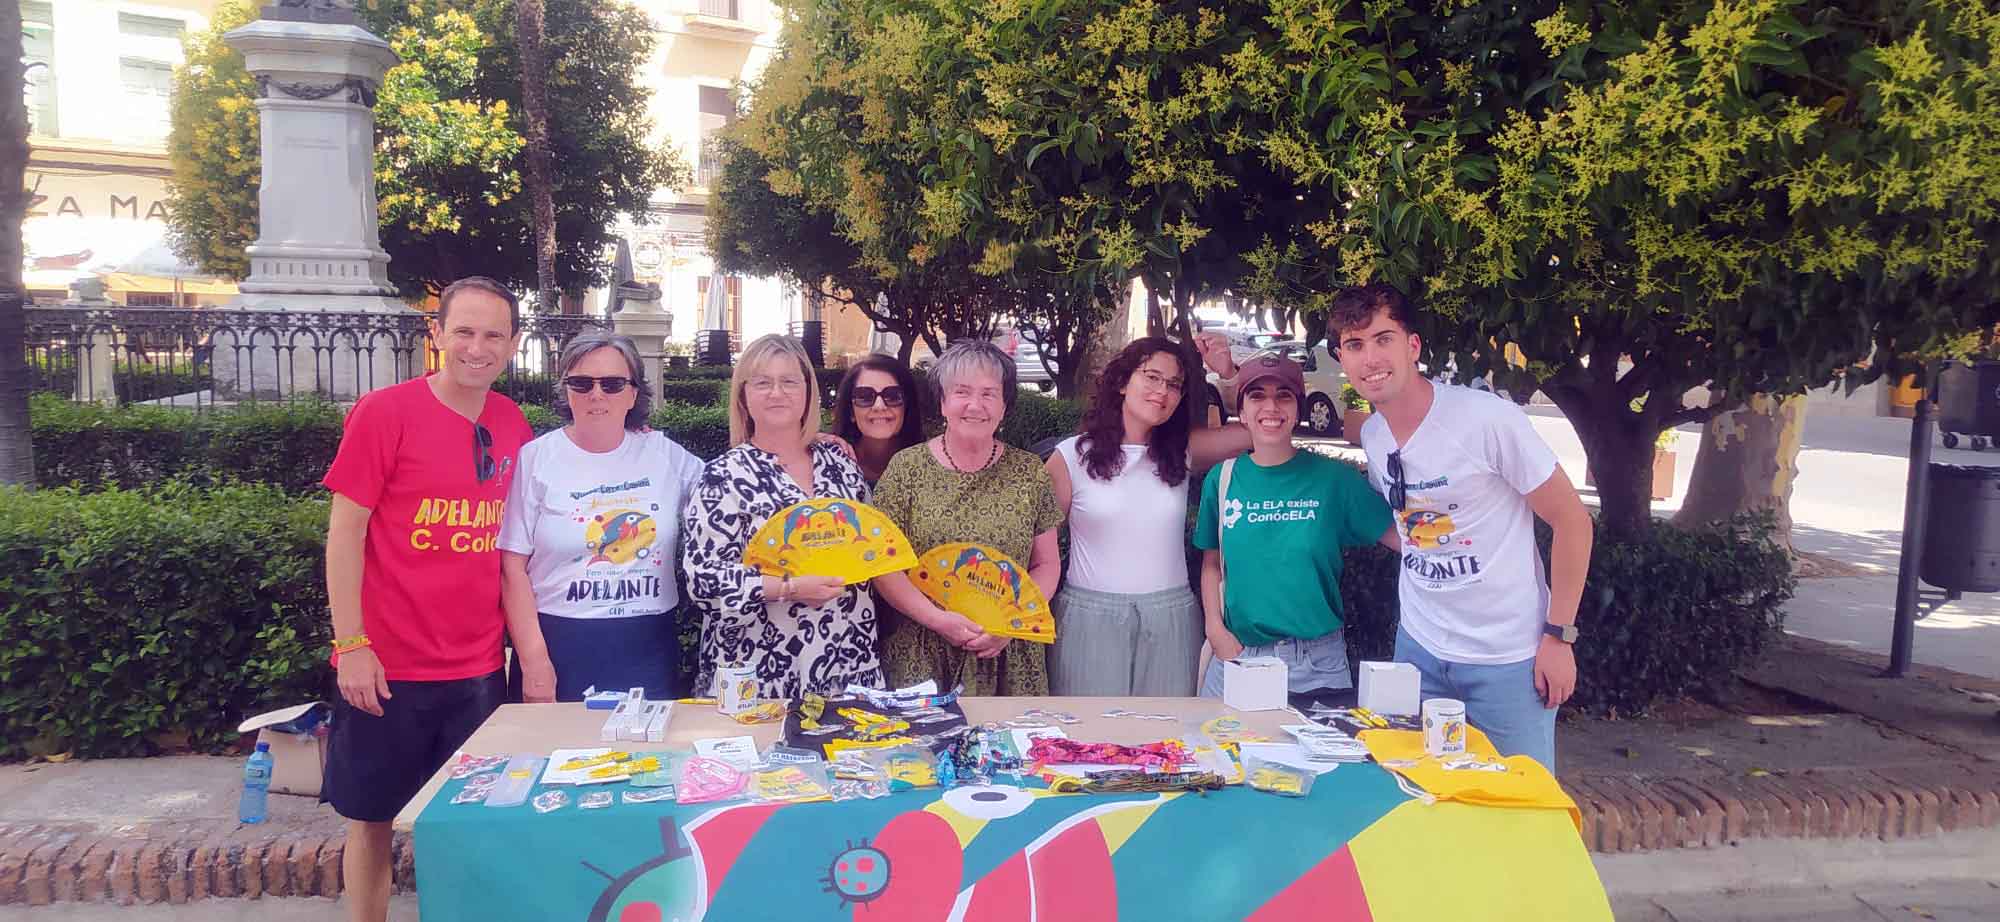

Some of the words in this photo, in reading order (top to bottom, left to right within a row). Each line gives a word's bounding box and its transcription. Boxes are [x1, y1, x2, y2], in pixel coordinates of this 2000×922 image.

[1246, 500, 1260, 510] La
[1263, 500, 1284, 510] ELA
[1287, 499, 1320, 508] existe
[1247, 509, 1316, 523] ConócELA
[410, 528, 440, 551] C.
[566, 575, 661, 602] ADELANTE
